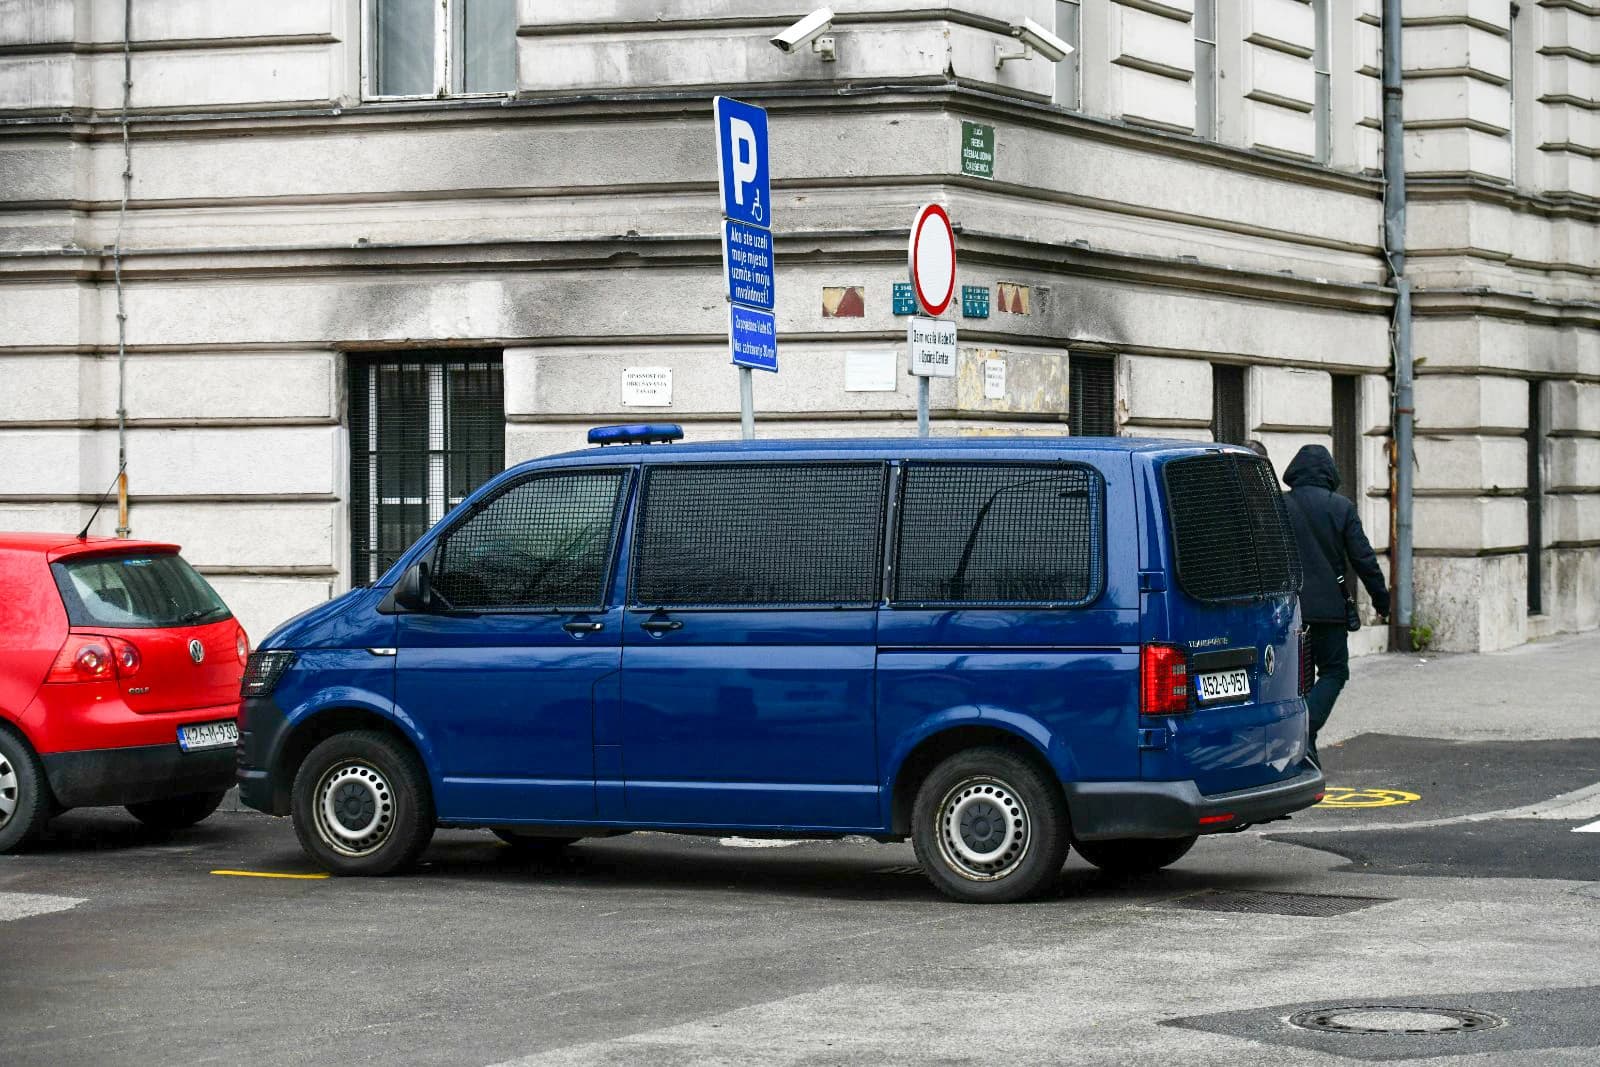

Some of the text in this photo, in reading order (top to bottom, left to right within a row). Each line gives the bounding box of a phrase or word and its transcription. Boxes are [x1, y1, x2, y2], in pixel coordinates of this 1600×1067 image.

[730, 117, 758, 206] P
[731, 226, 768, 249] Ako ste uzeli
[732, 248, 768, 269] moje mjesto
[731, 266, 751, 282] uzmite
[755, 271, 770, 289] moju
[735, 283, 769, 304] invalidnost!
[128, 686, 150, 694] GOLF
